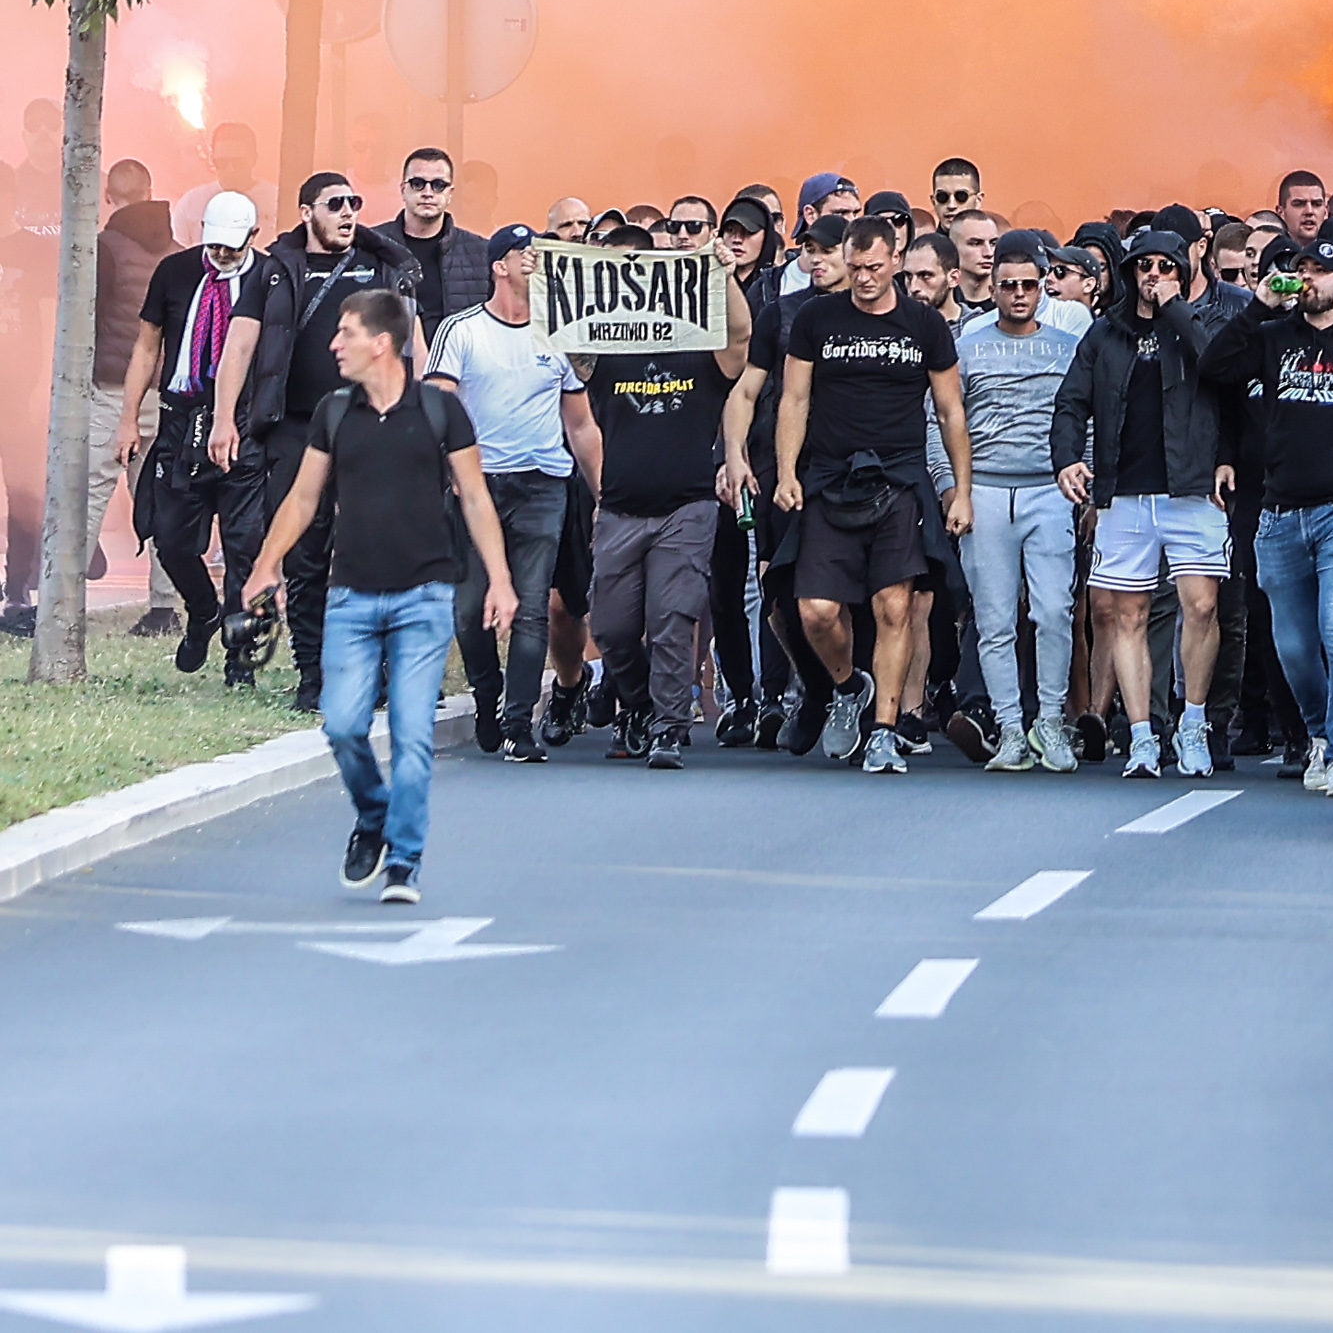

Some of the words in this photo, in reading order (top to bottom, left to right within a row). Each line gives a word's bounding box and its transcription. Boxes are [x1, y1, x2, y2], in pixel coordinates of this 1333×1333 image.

[544, 250, 711, 337] KLOŠARI
[588, 322, 648, 342] MRZIMO
[976, 341, 1069, 357] EMPIRE
[614, 381, 661, 395] TORCIDA
[661, 378, 694, 394] SPLIT
